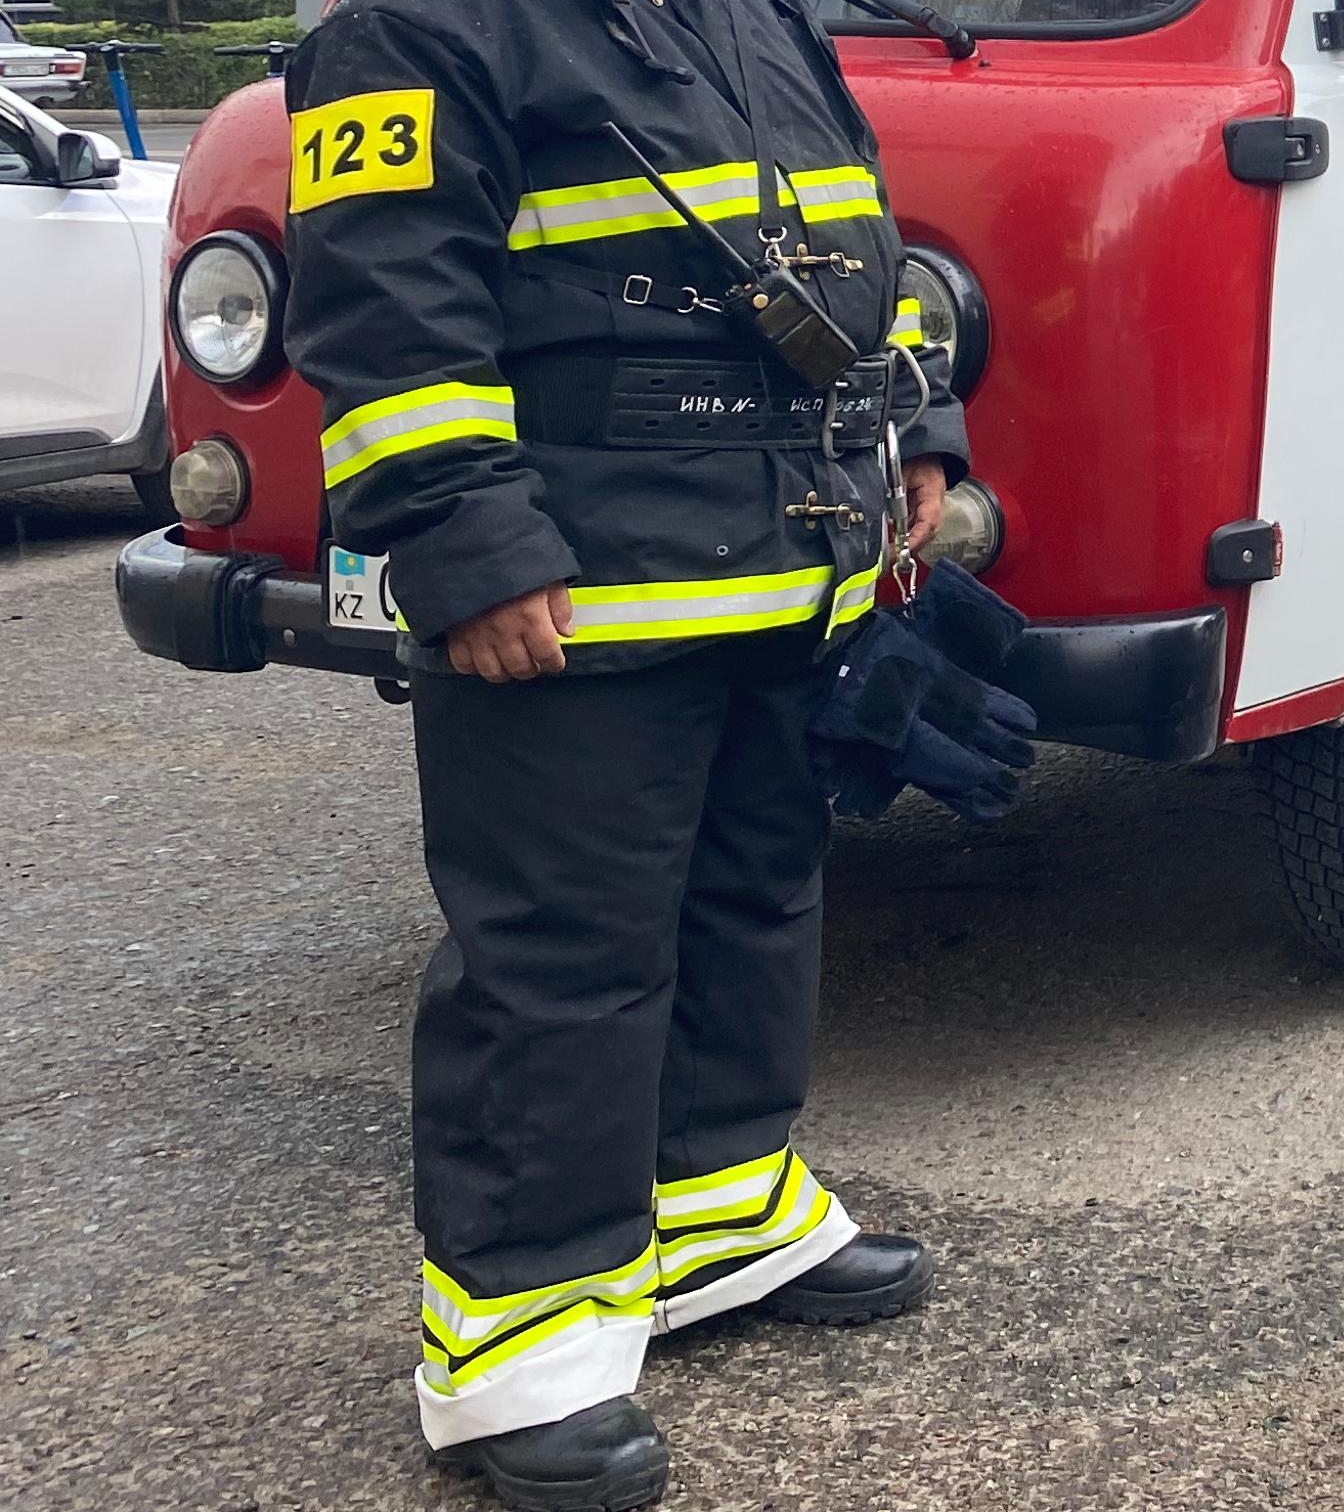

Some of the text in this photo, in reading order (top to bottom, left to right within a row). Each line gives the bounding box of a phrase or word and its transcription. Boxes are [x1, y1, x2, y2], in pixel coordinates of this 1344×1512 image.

[302, 114, 418, 184] 123
[680, 396, 725, 413] ИНВ
[335, 592, 363, 620] KZ
